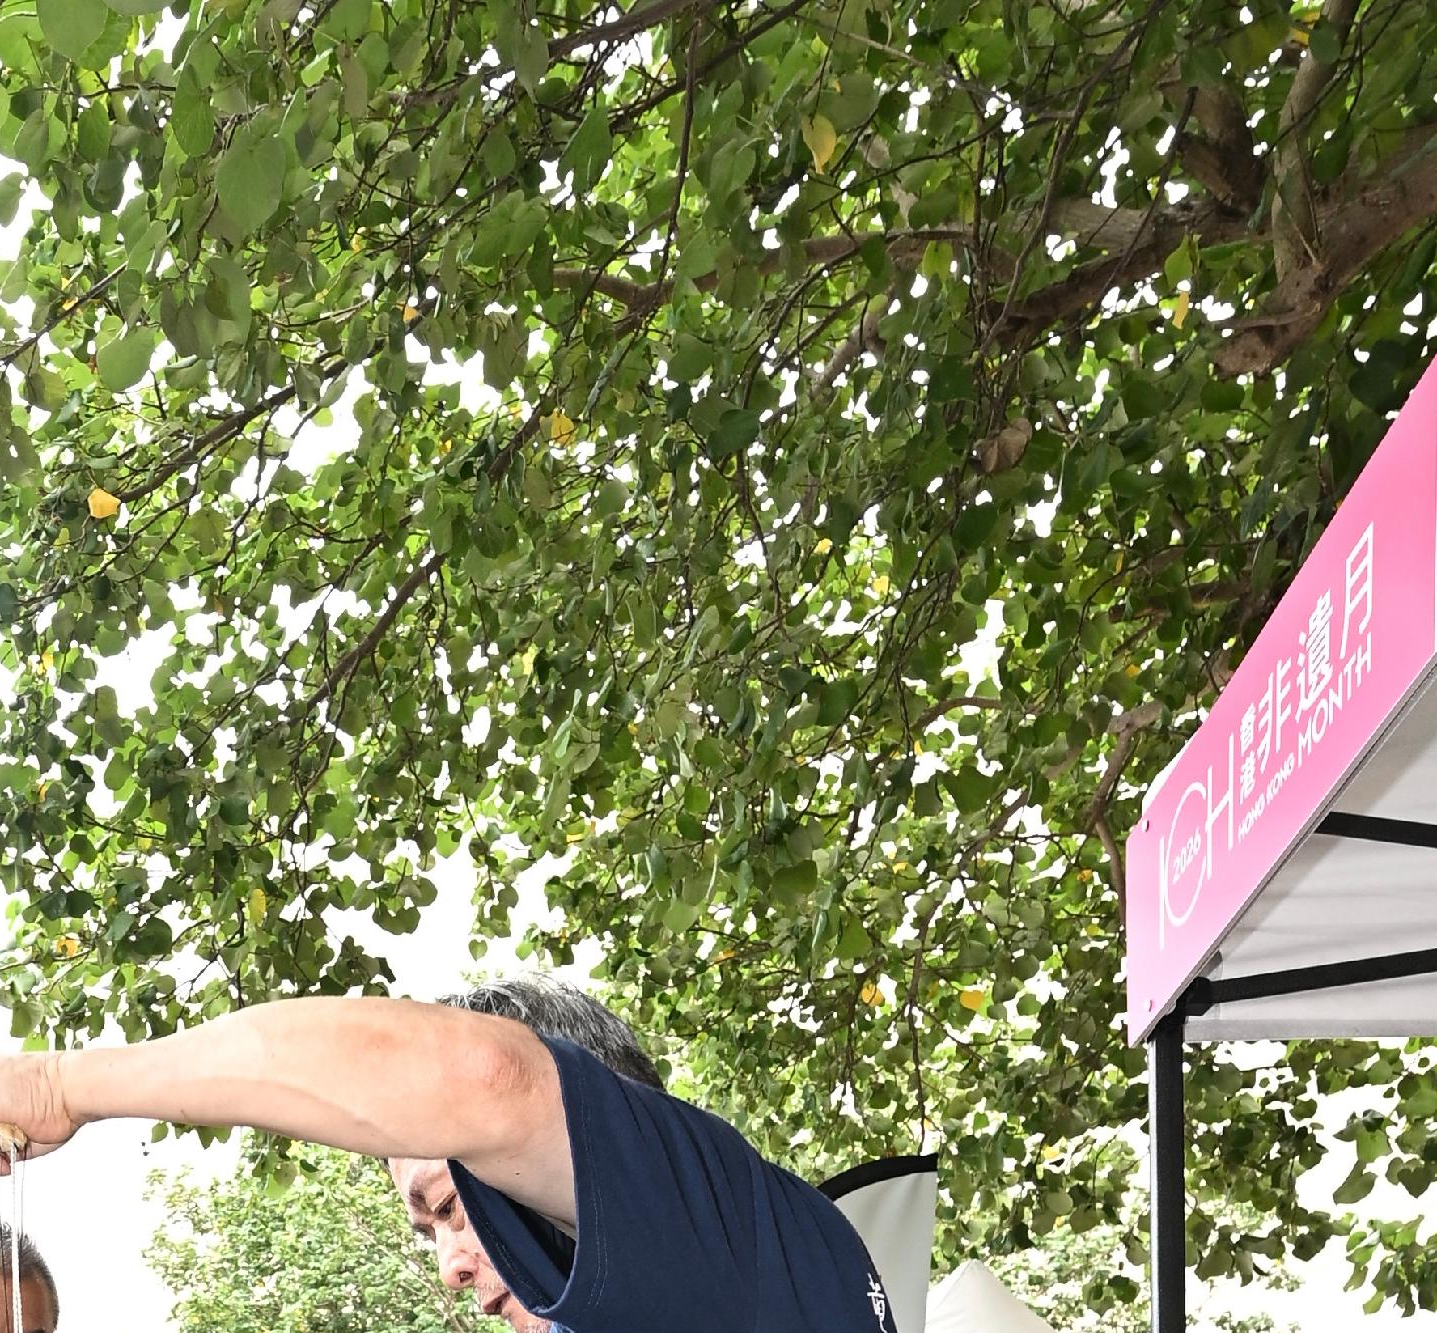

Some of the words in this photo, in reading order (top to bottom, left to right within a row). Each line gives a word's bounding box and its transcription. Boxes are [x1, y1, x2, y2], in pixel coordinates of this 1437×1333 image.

[1238, 793, 1265, 843] HONG
[1266, 752, 1295, 804] KONG
[1297, 631, 1371, 768] MONTH
[1257, 521, 1374, 775] 非遺月
[1159, 732, 1235, 951] ICH
[1172, 827, 1202, 885] 2026
